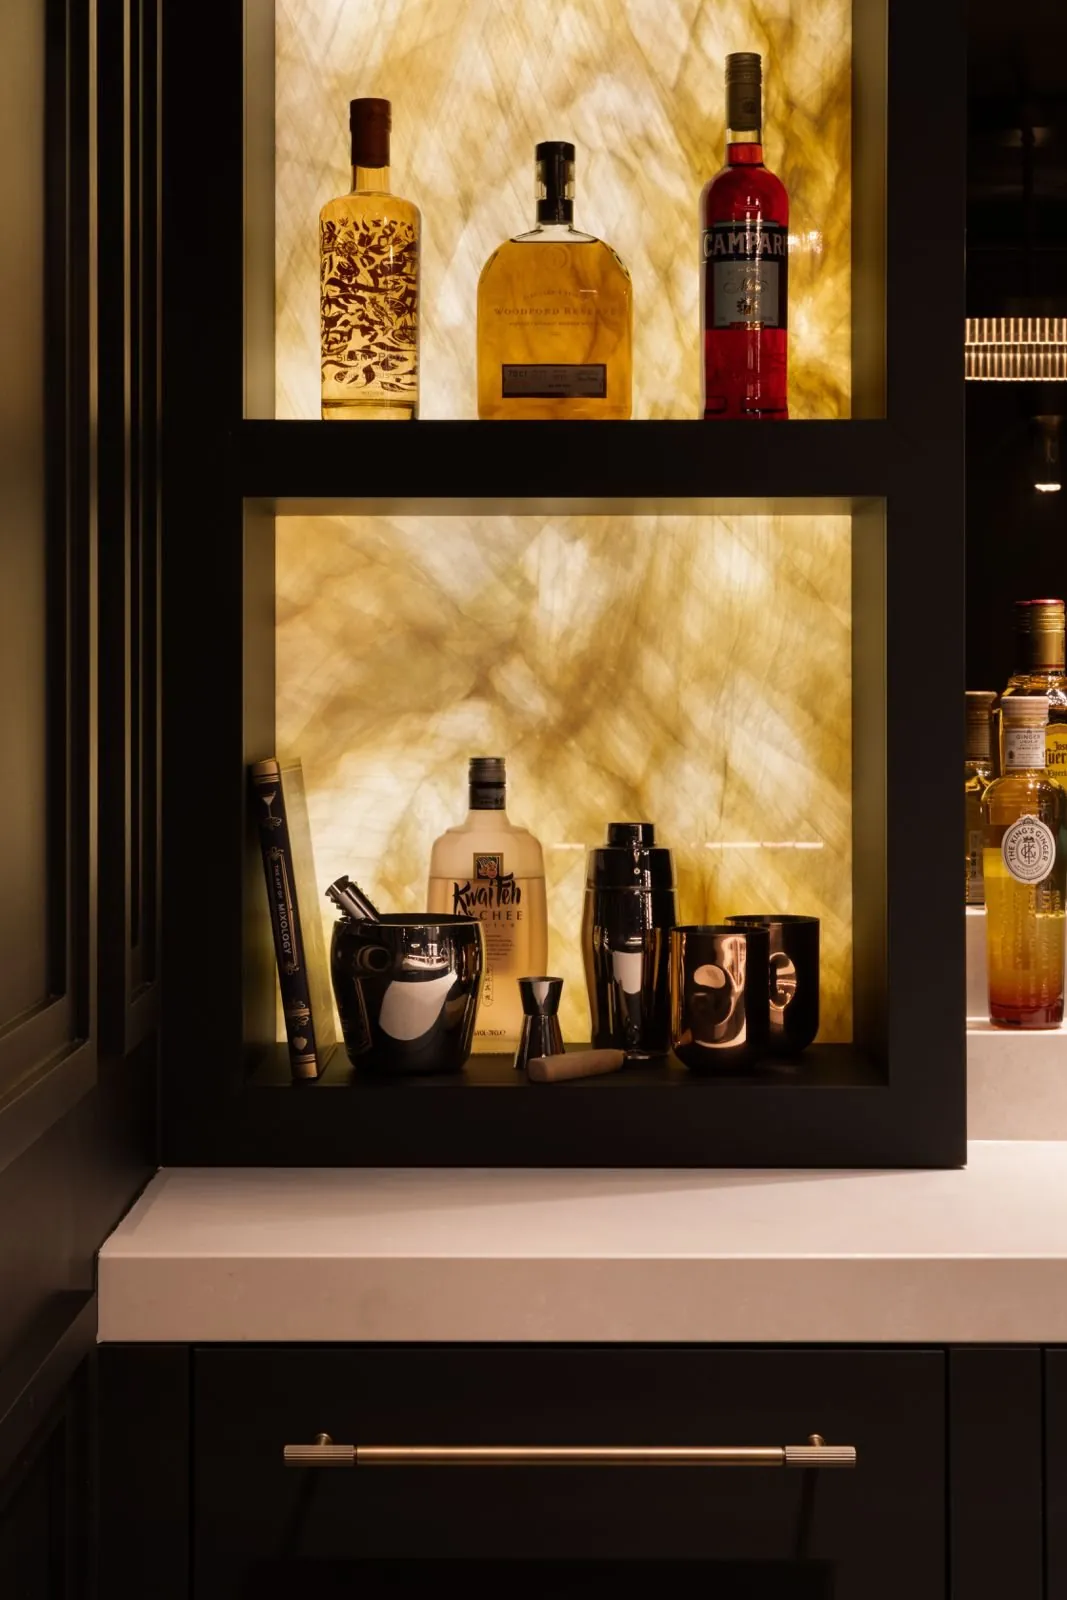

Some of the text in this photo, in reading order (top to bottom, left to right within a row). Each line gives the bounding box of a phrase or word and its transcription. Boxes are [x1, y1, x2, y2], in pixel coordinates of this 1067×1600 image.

[704, 232, 786, 257] CAMPARI
[494, 307, 560, 316] WOODFORD
[1008, 827, 1050, 862] THE KING'S GINGER
[278, 903, 292, 954] MIXOLOGY
